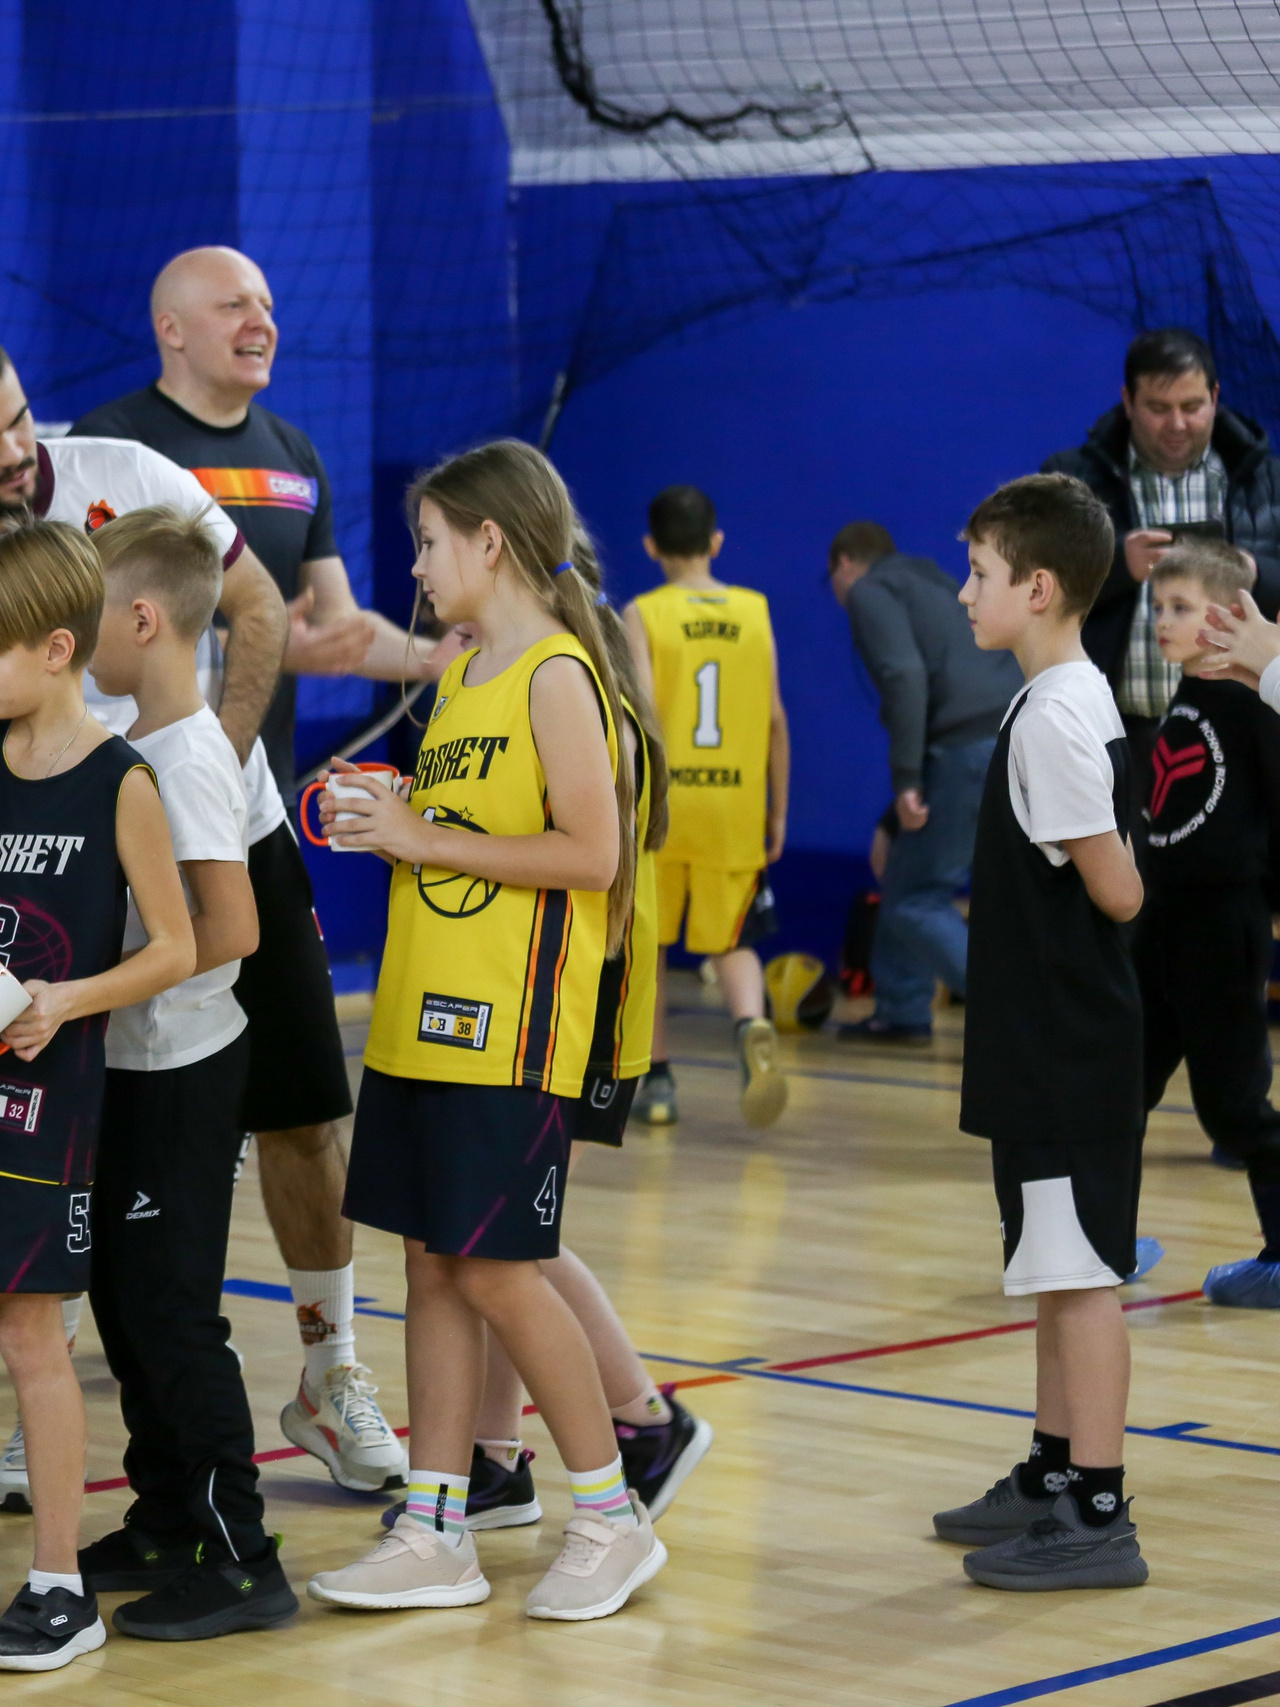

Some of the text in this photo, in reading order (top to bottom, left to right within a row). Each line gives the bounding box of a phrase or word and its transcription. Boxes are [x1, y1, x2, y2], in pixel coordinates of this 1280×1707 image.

[694, 660, 721, 748] 1
[457, 1022, 471, 1036] 38
[9, 1103, 24, 1120] 32
[534, 1166, 557, 1226] 4
[125, 1208, 161, 1220] DEMIX
